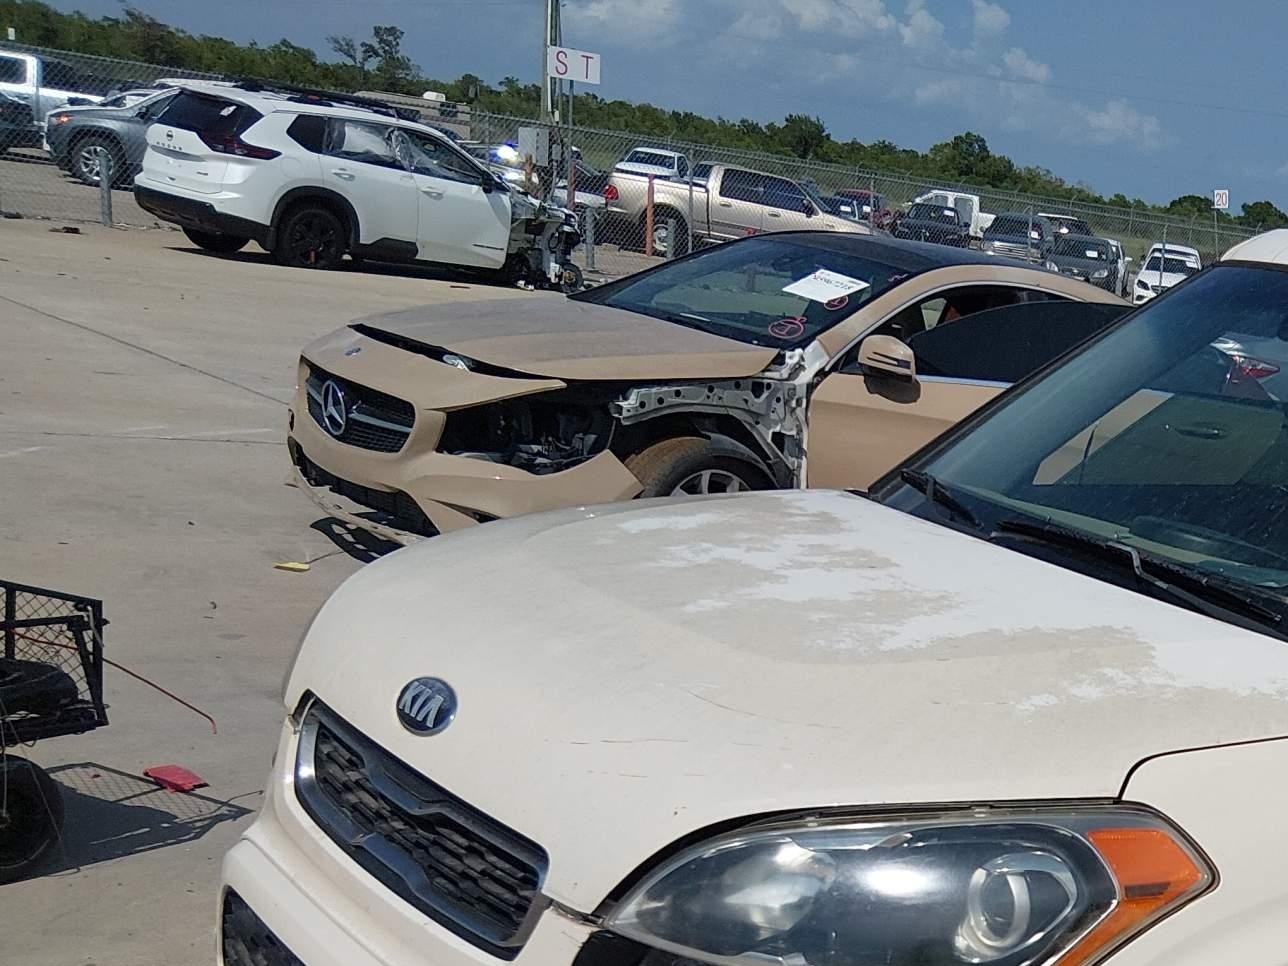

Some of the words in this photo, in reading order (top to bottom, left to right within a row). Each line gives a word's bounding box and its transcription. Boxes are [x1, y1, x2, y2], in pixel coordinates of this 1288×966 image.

[555, 50, 568, 76] S
[580, 54, 594, 80] T
[1215, 192, 1228, 207] 20
[398, 680, 445, 729] KIA
